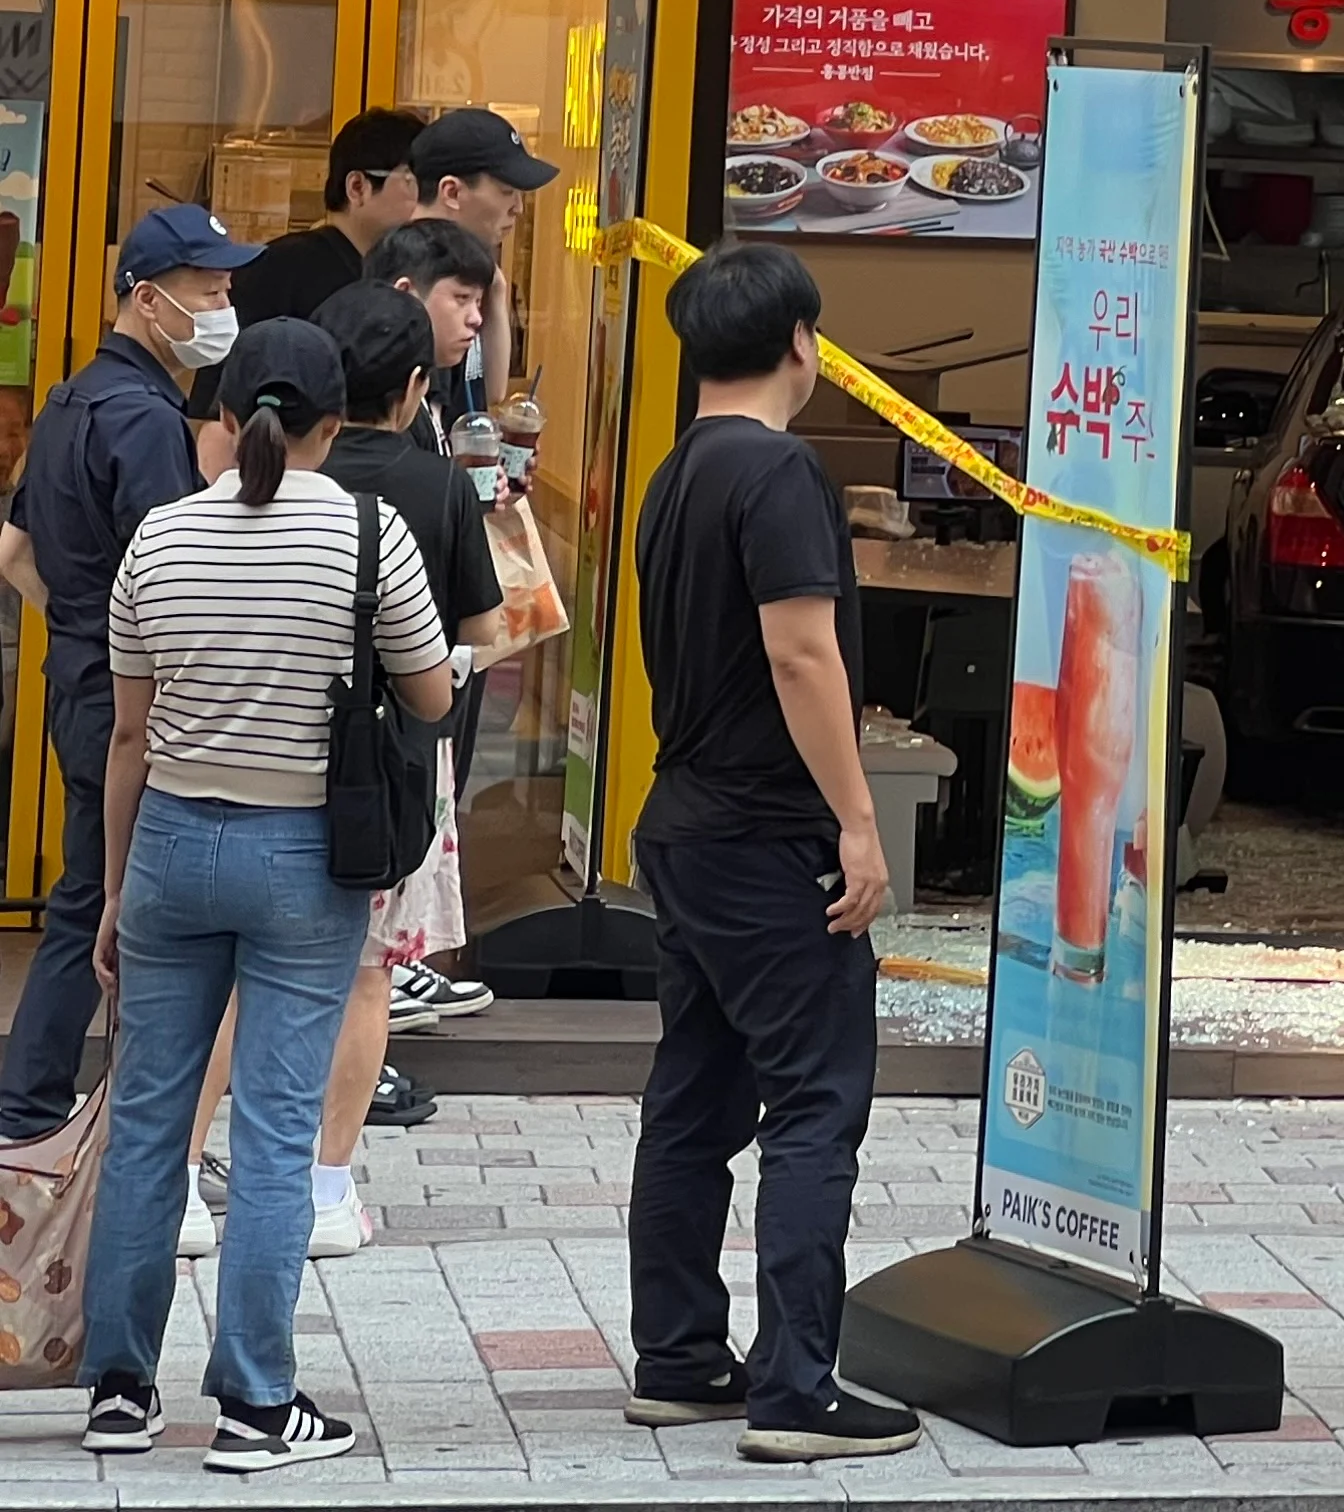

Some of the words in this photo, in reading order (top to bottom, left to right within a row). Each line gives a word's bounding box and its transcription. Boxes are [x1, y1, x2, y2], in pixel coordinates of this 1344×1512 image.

[762, 5, 824, 30] 가격의
[828, 7, 889, 31] 거품을
[893, 9, 935, 31] 빼고
[774, 37, 823, 57] 그리고
[1088, 288, 1139, 356] 우리
[1046, 361, 1115, 461] 수박
[1054, 1204, 1121, 1251] COFFEE
